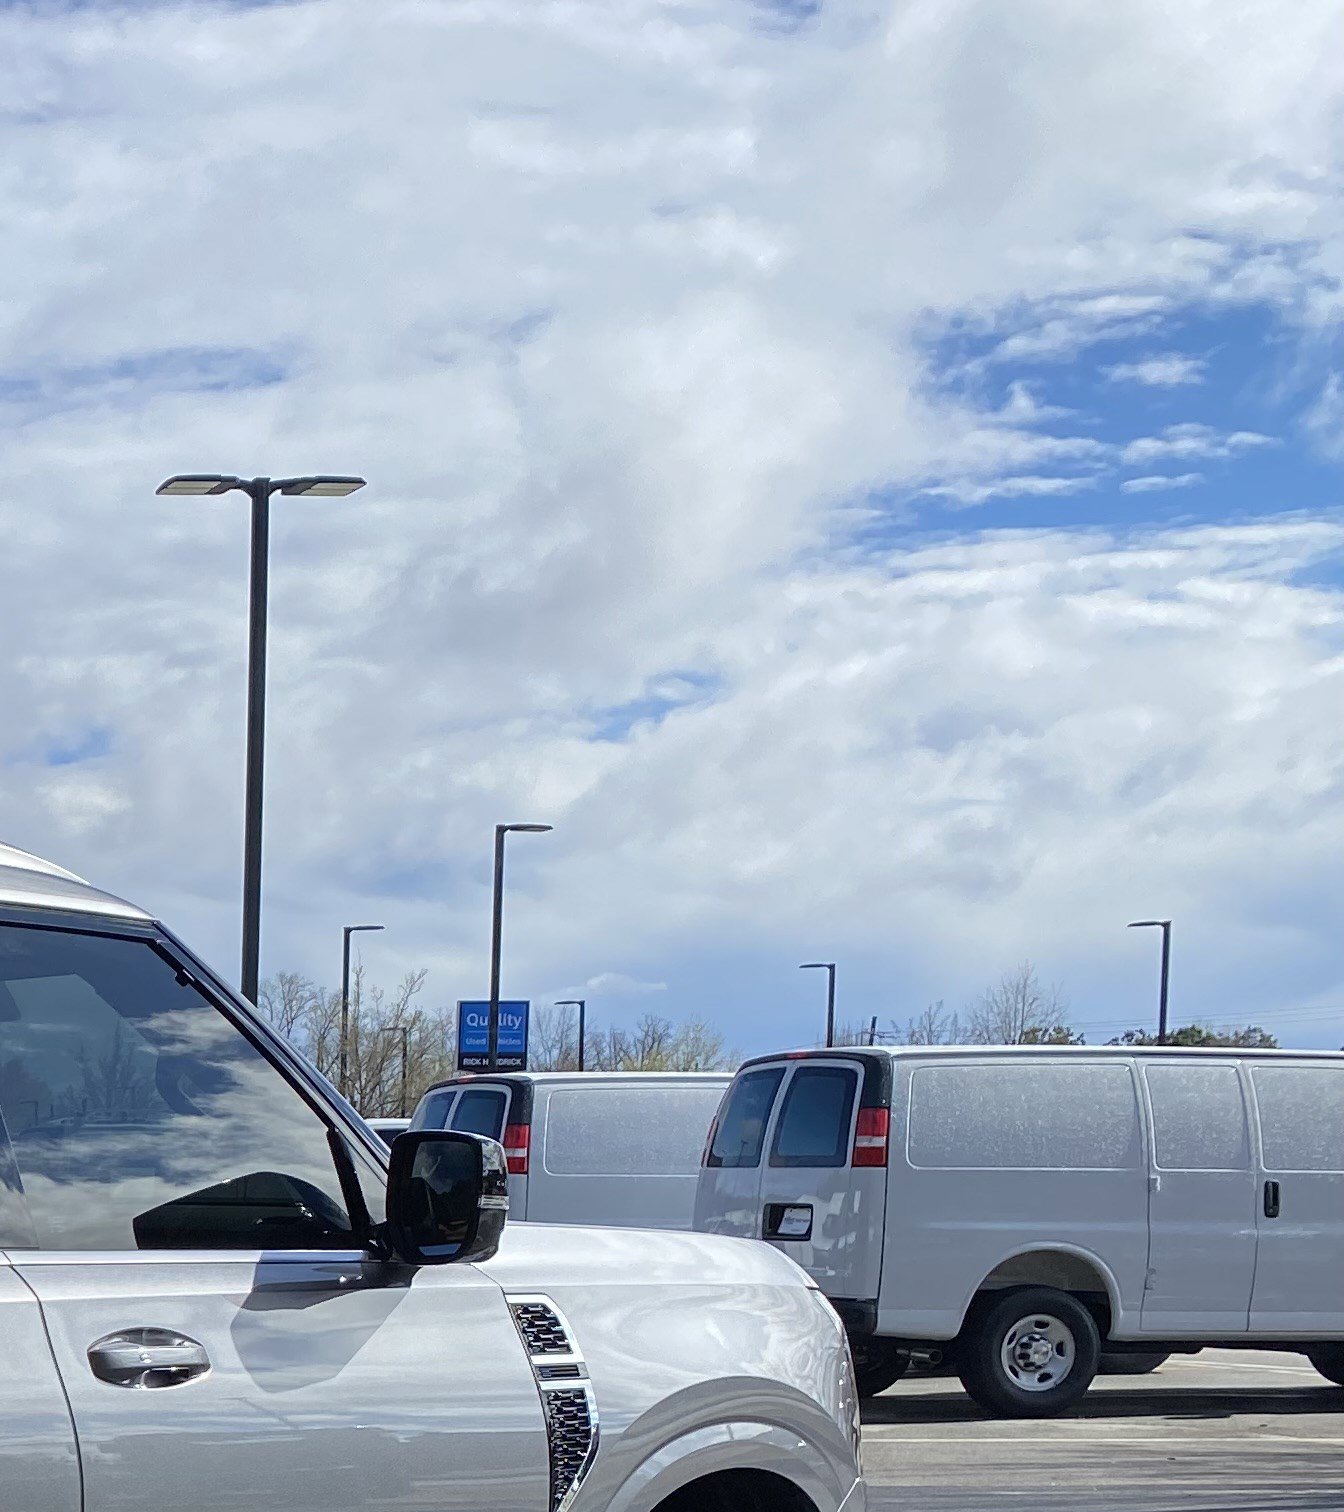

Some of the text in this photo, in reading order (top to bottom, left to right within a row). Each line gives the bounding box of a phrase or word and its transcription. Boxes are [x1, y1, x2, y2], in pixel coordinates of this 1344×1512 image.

[466, 1013, 522, 1030] Qulity
[465, 1037, 486, 1045] Used
[483, 1058, 522, 1066] HDRICK
